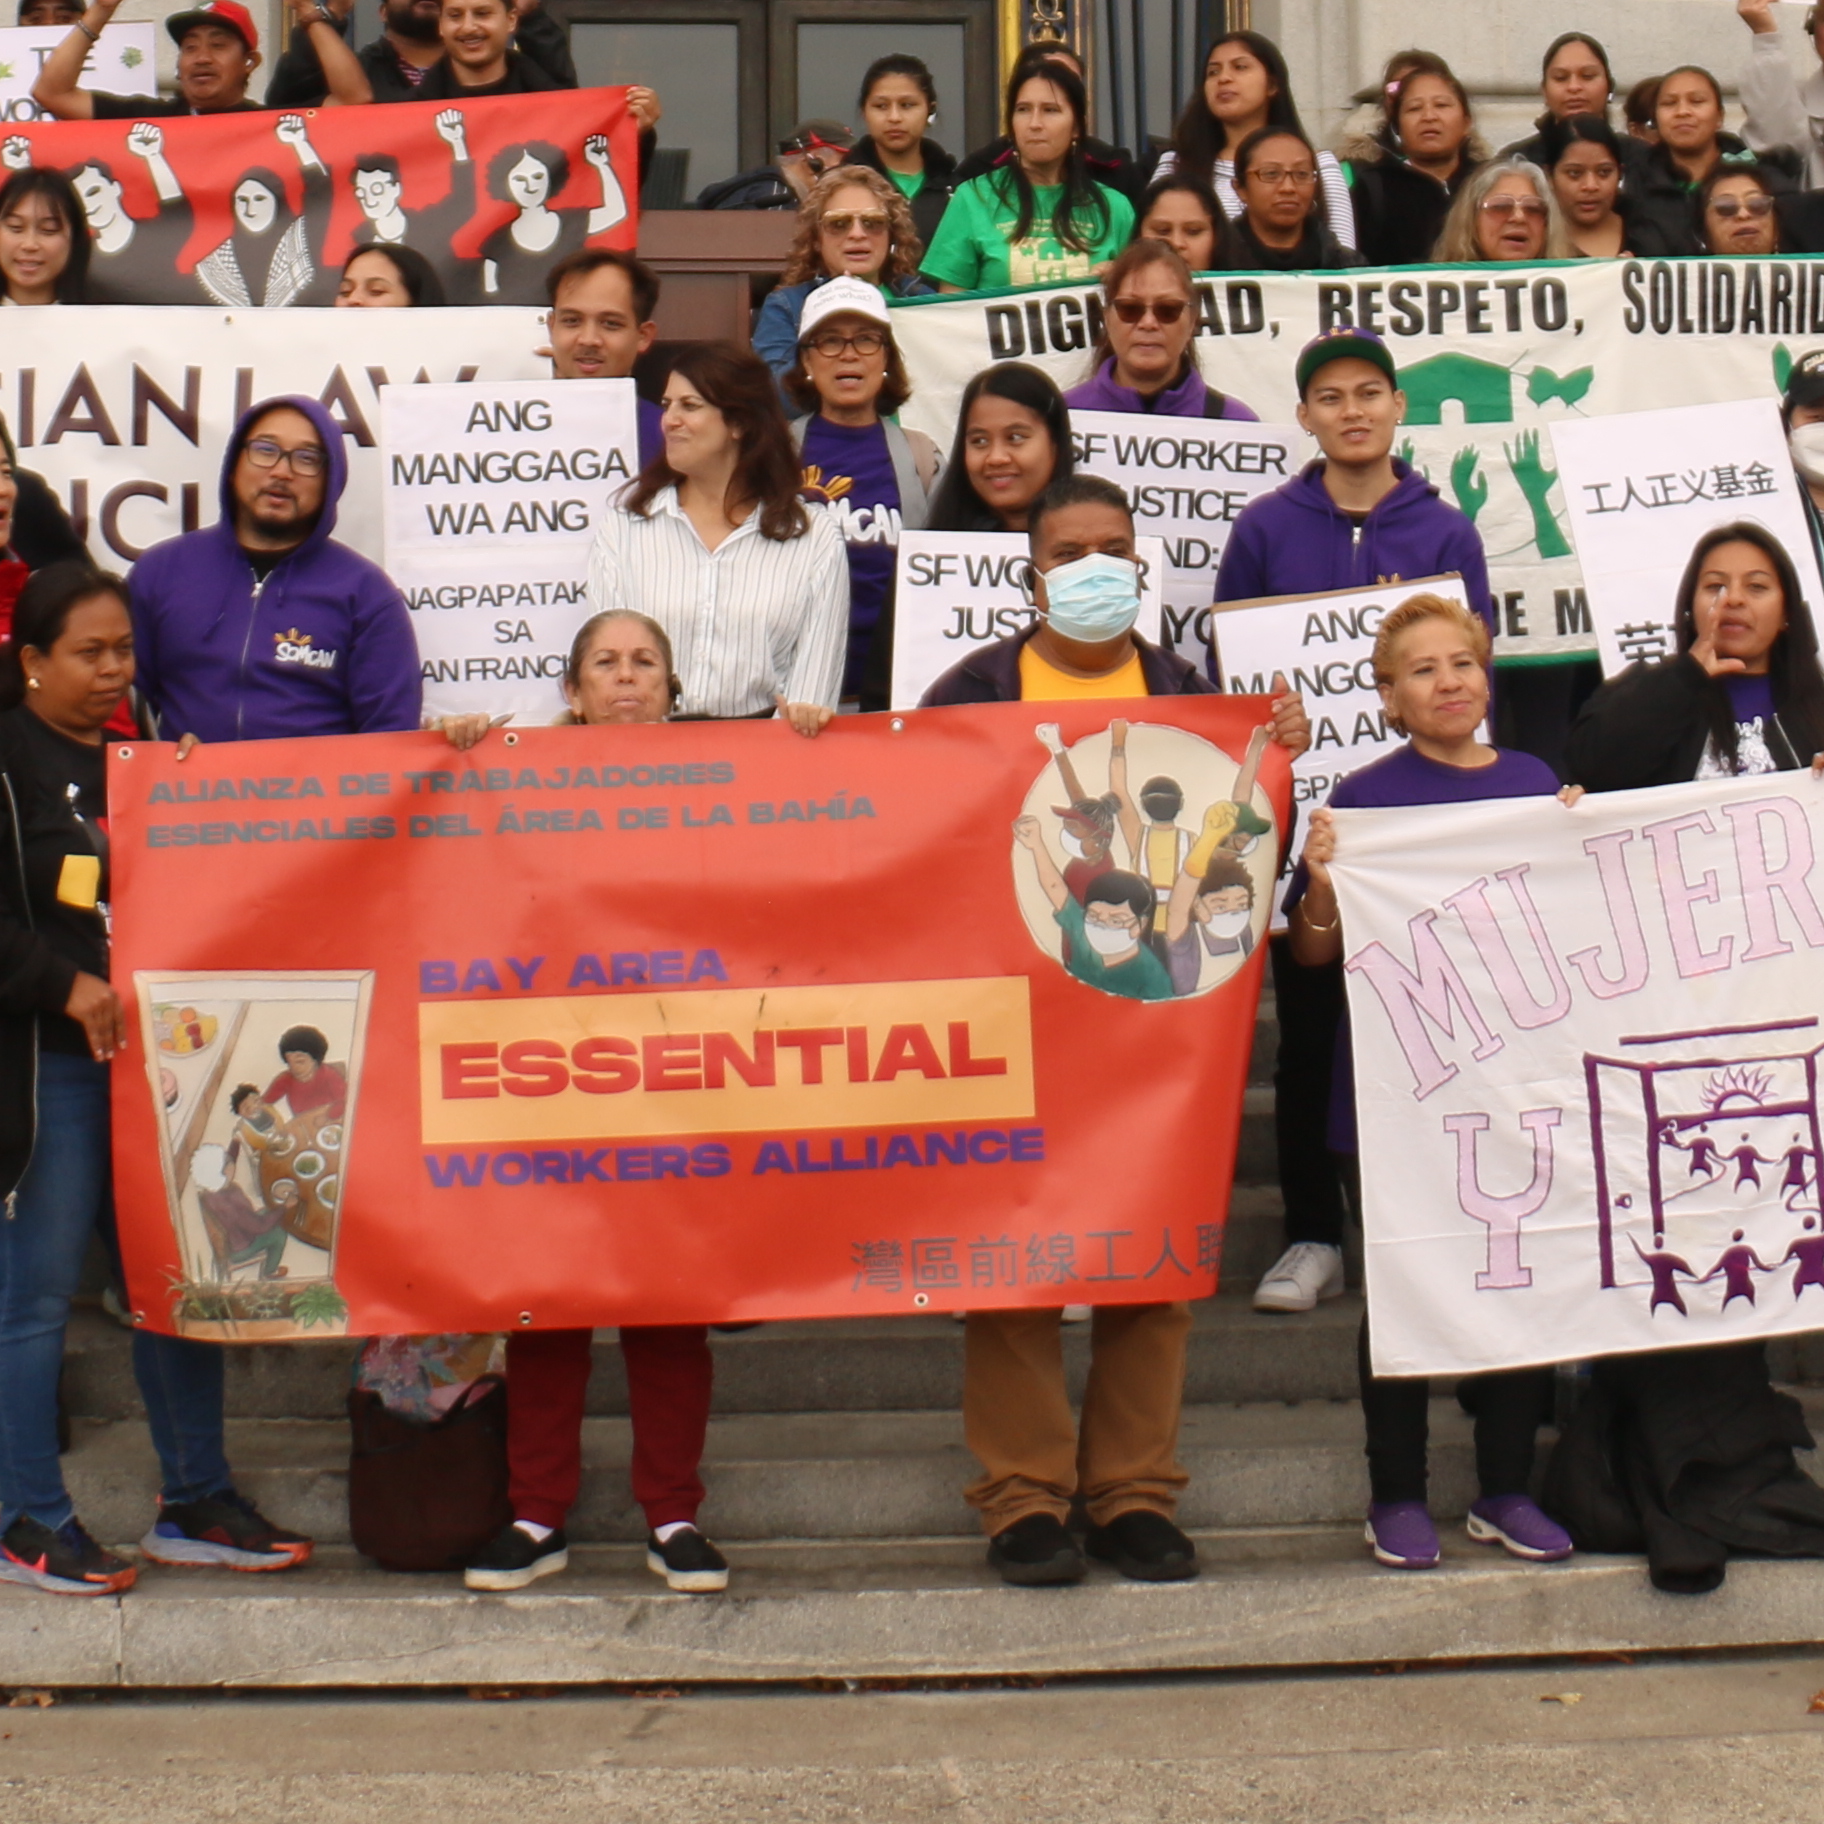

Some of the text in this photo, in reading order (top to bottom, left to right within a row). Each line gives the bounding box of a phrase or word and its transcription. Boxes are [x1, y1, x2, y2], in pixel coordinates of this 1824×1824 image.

[1317, 276, 1585, 337] RESPETO,
[465, 399, 554, 434] ANG
[390, 447, 632, 487] MANGGAGA
[1114, 435, 1288, 475] WORKER
[1129, 485, 1248, 522] USTICE
[1583, 460, 1780, 515] 工人正义基金
[424, 499, 591, 536] WA ANG
[907, 552, 959, 586] SF
[1163, 537, 1219, 571] ND:
[493, 619, 534, 645] SA
[419, 652, 571, 683] AN FRANCI
[147, 760, 736, 805] ALIANZA DE TRABAJADORES
[145, 788, 876, 849] ESENCIALES DEL ÁREA DE LA BAHÍA
[419, 948, 729, 995] BAY AREA
[440, 1020, 1009, 1101] ESSENTIAL
[422, 1126, 1045, 1189] WORKERS ALLIANCE
[1443, 1107, 1564, 1292] Y
